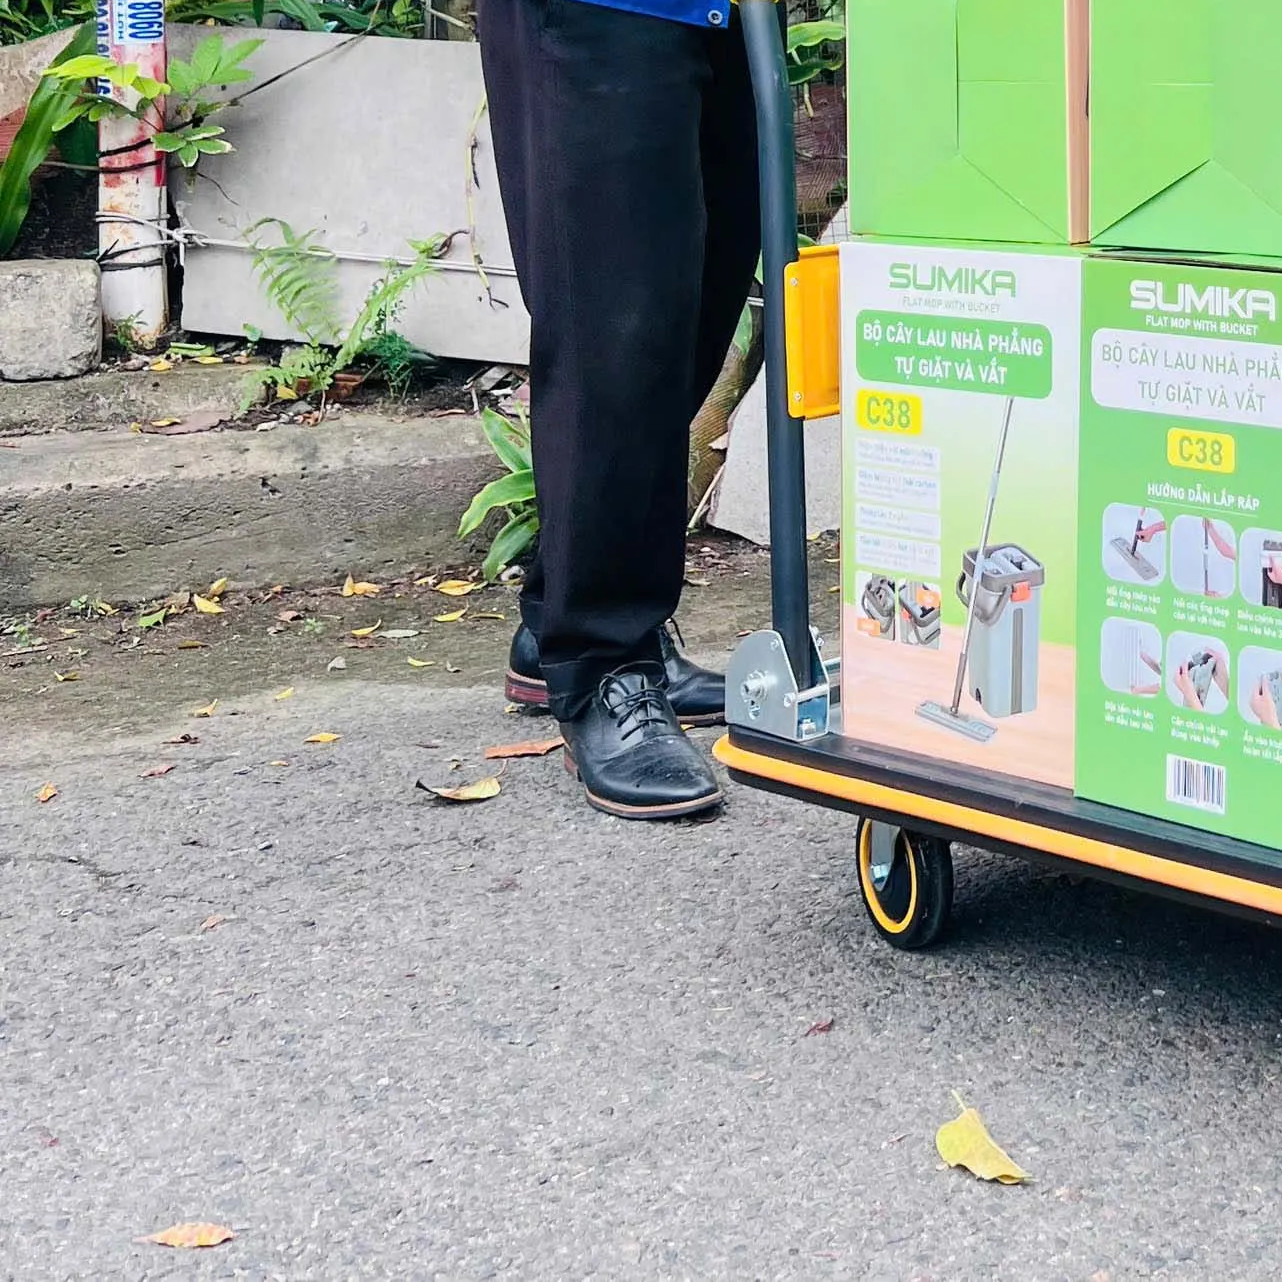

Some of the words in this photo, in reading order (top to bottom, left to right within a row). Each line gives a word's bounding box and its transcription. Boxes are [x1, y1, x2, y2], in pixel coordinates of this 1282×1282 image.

[889, 262, 1016, 298] SUMIKA
[902, 296, 924, 306] FLAT
[925, 298, 943, 307] MOP
[945, 300, 965, 311] WITH
[968, 301, 1001, 313] BUCKET
[1129, 279, 1276, 321] SUMIKA
[863, 320, 881, 346] BỘ
[886, 323, 915, 342] CÂY
[917, 329, 946, 346] LAU
[951, 329, 983, 351] NHÀ
[988, 327, 1043, 356] PHẲNG
[1146, 315, 1169, 328] FLAT
[1170, 318, 1191, 329] MOP
[1193, 320, 1217, 332] WITH
[1220, 322, 1258, 336] BUCKET
[894, 356, 915, 380] TỰ
[919, 357, 952, 383] GIẶT
[954, 357, 977, 381] VÀ
[979, 357, 1008, 385] VẮT
[1102, 340, 1123, 369] BỘ
[1128, 343, 1159, 364] CÂY
[1164, 352, 1197, 370] LAU
[1202, 353, 1240, 376] NHÀ
[1138, 380, 1161, 405] TỰ
[1166, 381, 1203, 410] GIẶT
[1207, 386, 1229, 409] VÀ
[1234, 384, 1266, 412] VẮT
[866, 396, 912, 429] C38
[1178, 435, 1223, 466] C38
[1148, 482, 1185, 498] HƯỚNG
[1187, 484, 1211, 504] DẪN
[1213, 488, 1235, 506] LẮP
[1237, 495, 1260, 511] RÁP
